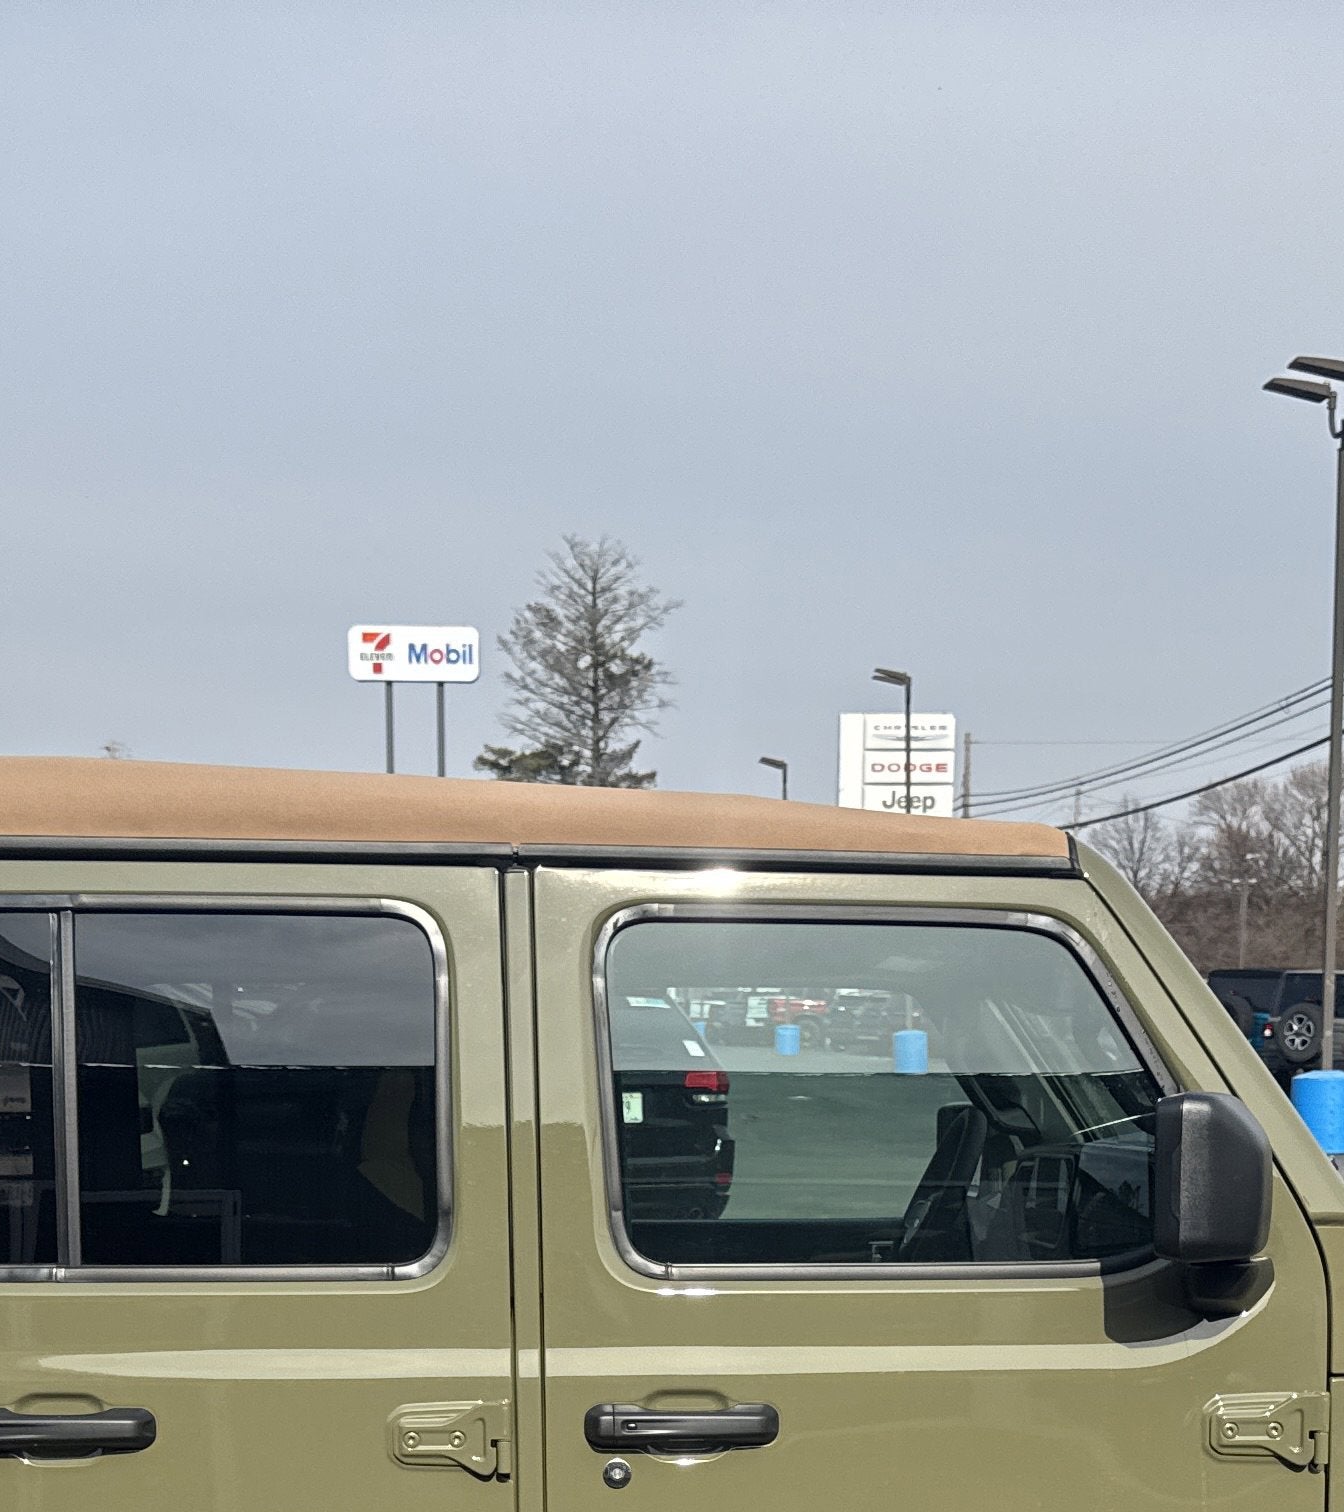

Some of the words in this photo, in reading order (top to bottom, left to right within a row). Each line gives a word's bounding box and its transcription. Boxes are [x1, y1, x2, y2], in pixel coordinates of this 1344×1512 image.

[407, 642, 474, 665] Mobil
[870, 762, 948, 773] DODGE
[881, 790, 936, 813] Jeep
